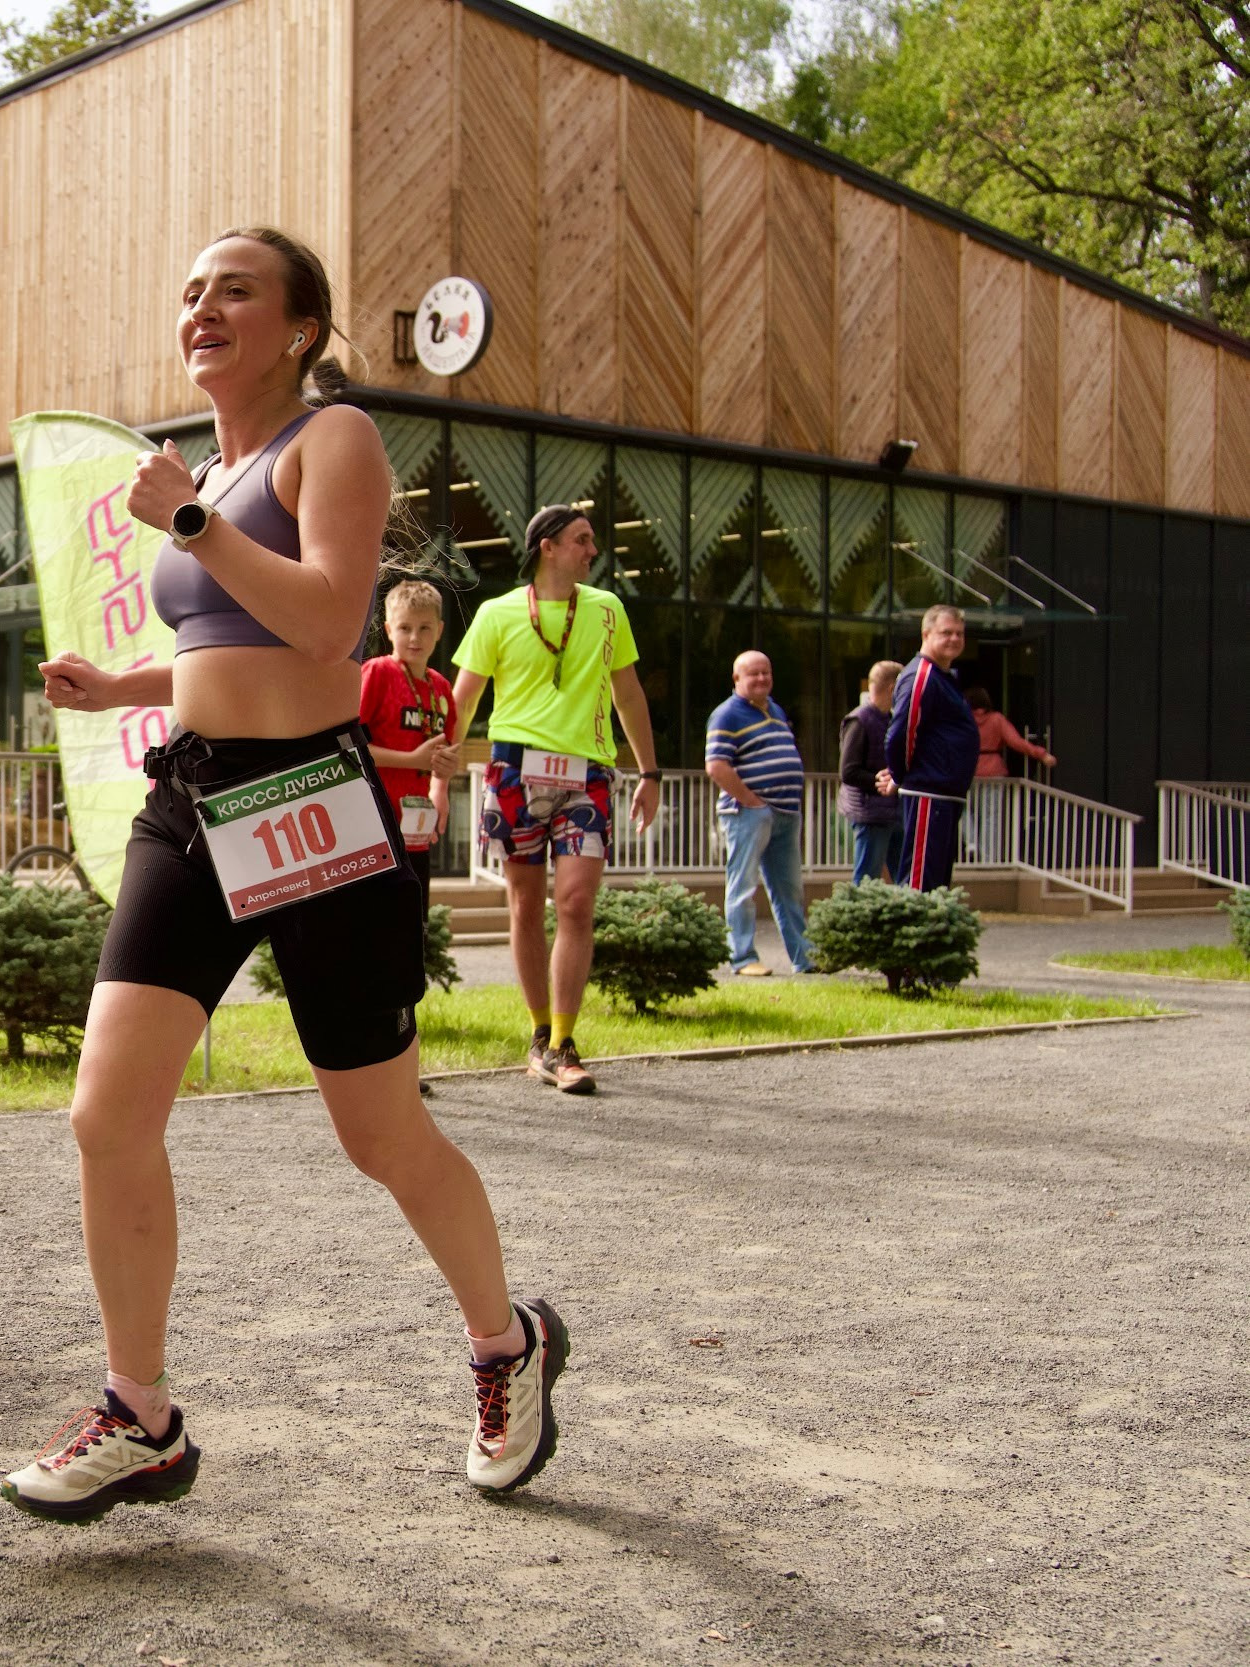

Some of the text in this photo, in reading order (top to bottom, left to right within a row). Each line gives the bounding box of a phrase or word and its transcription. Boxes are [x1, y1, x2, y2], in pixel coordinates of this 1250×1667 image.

[216, 763, 346, 818] КРОСС ДУБКИ
[543, 756, 569, 776] 111
[252, 803, 337, 870] 110
[247, 854, 377, 905] Апрелевка 14.09.25
